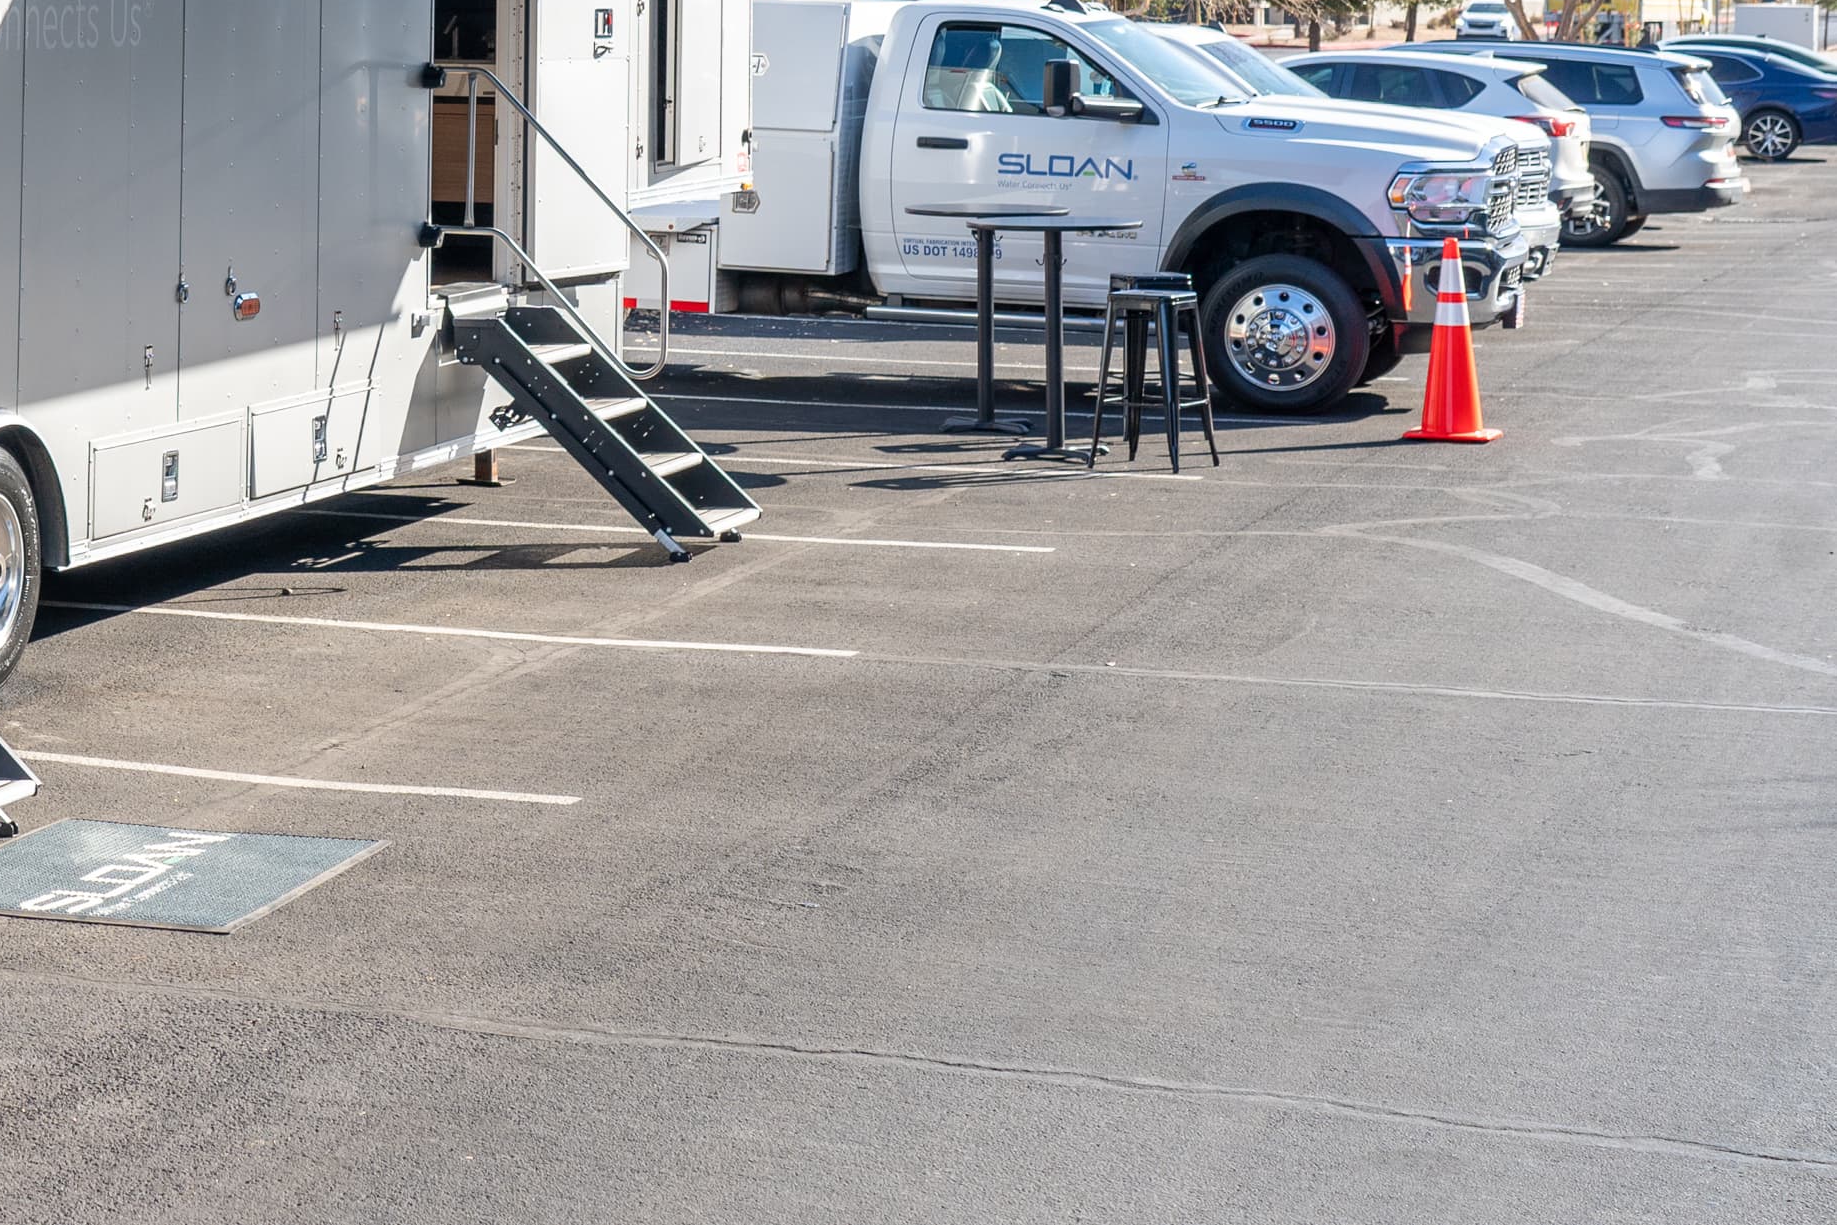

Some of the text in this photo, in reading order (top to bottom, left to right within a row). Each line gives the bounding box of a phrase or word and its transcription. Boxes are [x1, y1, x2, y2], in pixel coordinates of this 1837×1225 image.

[1253, 119, 1295, 127] 5500
[903, 244, 1002, 259] US DOT 14989
[19, 832, 231, 914] SLOAN
